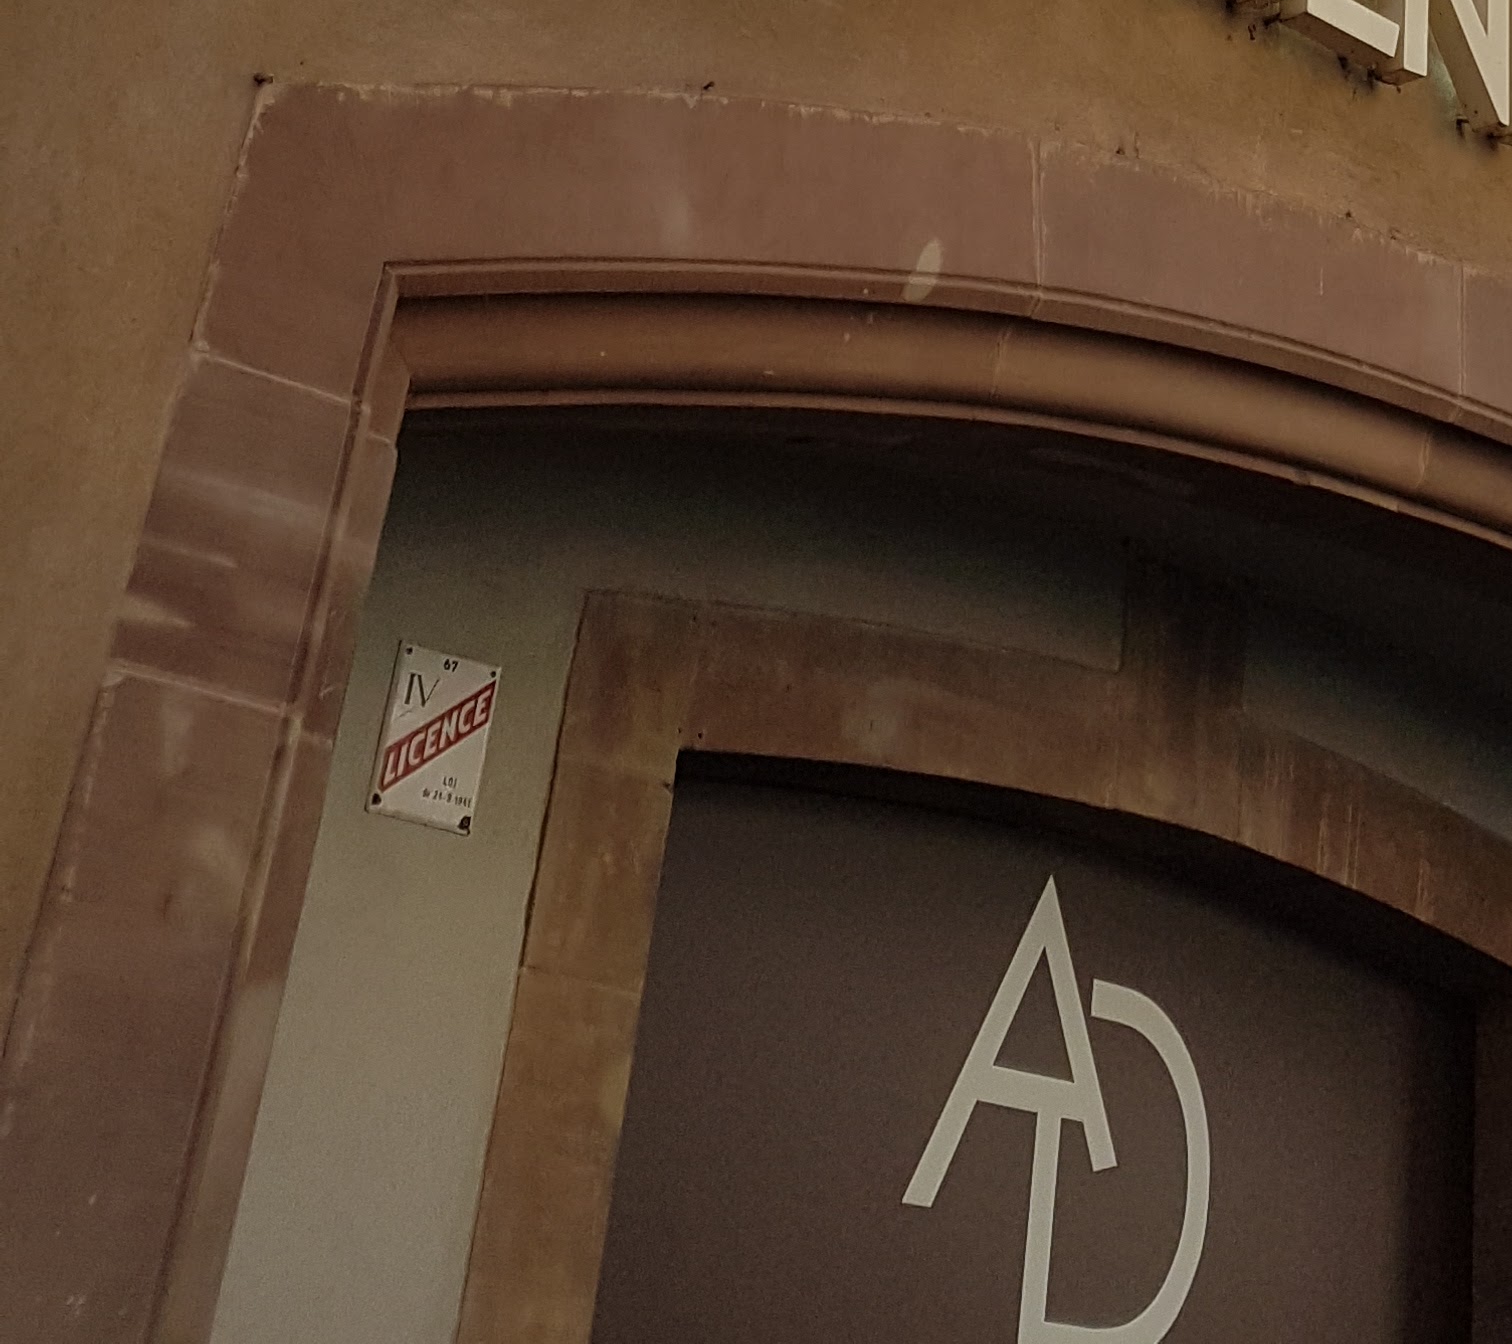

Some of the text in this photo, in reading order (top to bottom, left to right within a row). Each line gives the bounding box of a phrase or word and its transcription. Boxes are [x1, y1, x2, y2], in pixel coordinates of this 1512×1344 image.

[443, 658, 459, 672] 67
[404, 673, 440, 707] IV
[383, 688, 493, 784] LICENCE
